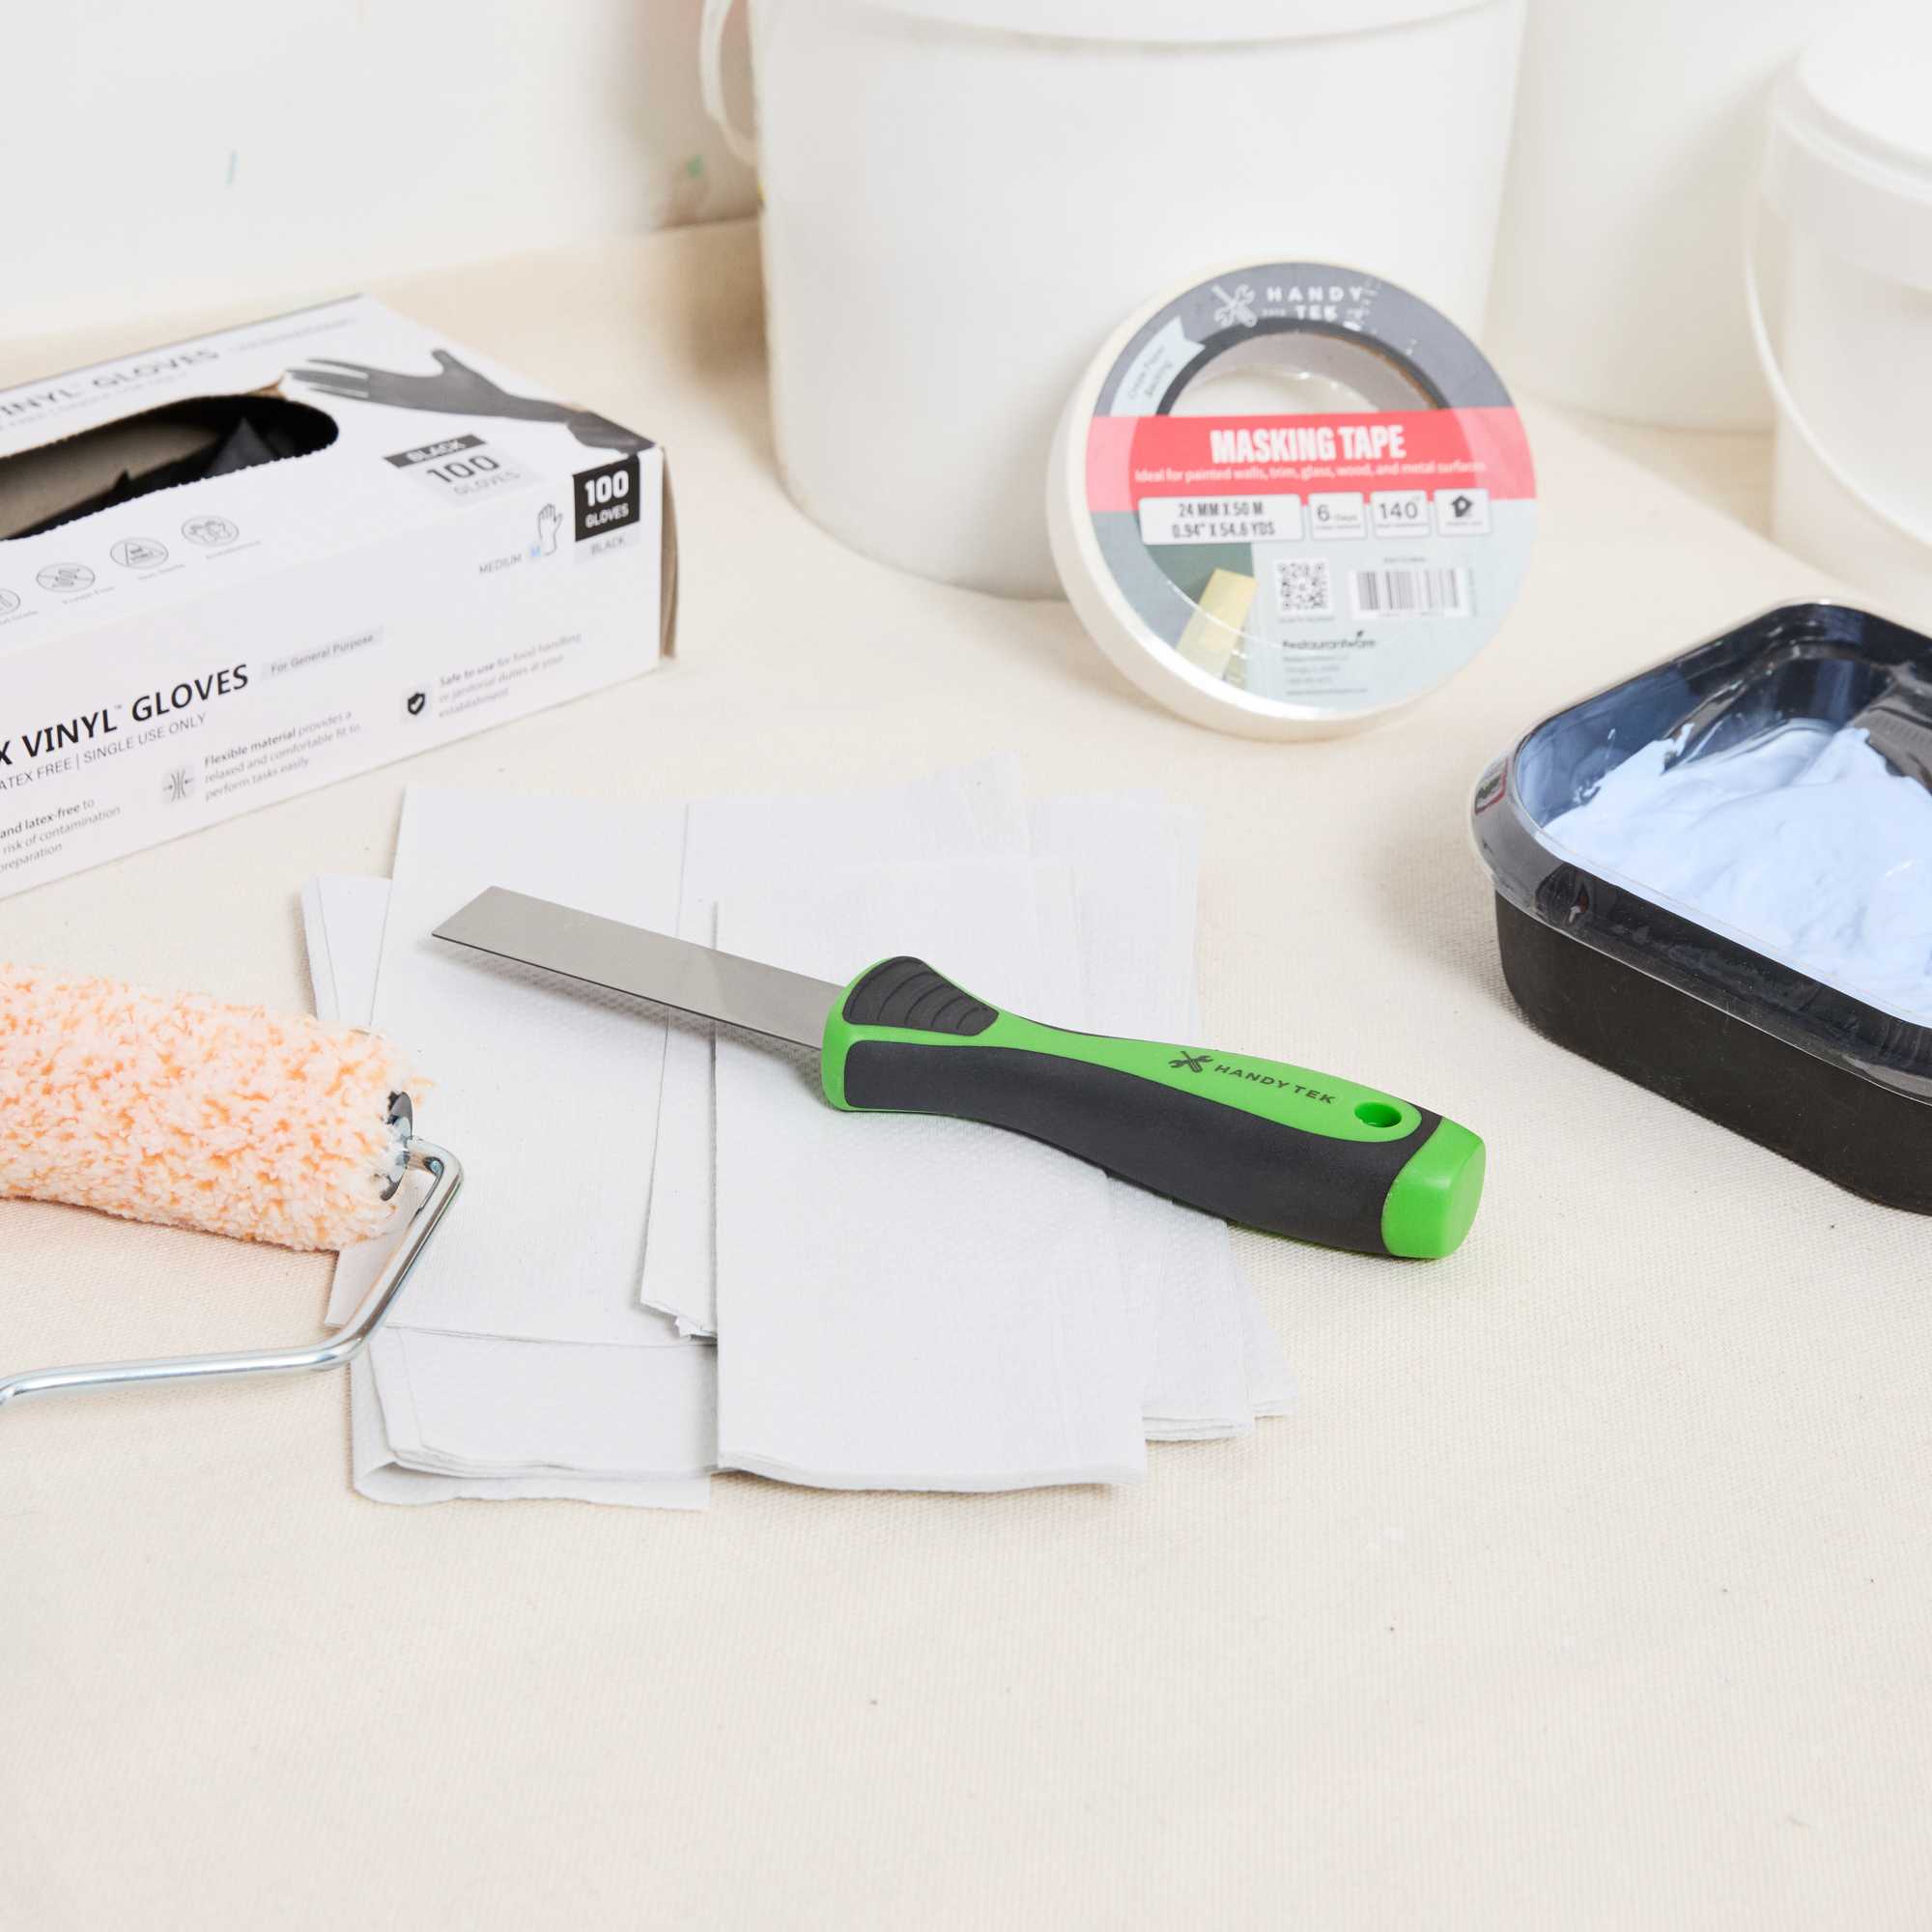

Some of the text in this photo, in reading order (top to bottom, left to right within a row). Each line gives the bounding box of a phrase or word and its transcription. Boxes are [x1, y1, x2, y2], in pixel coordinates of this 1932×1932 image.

[1266, 286, 1363, 302] HANDY
[1295, 305, 1338, 322] TEK
[406, 439, 468, 464] BLACK
[1209, 423, 1407, 465] MASKING TAPE
[426, 454, 500, 484] 100
[584, 469, 630, 507] 100
[585, 502, 630, 528] GLOVES
[1179, 502, 1194, 518] 24
[1197, 501, 1219, 517] MM
[1234, 500, 1250, 517] 50
[1253, 500, 1264, 516] M
[1316, 503, 1330, 523] 6
[590, 535, 626, 556] BLACK
[1251, 521, 1276, 536] YDS
[479, 553, 523, 575] MEDIUM
[270, 634, 375, 675] For General Purpose
[131, 664, 249, 723] GLOVES
[37, 756, 73, 781] FREE
[83, 736, 134, 765] SINGLE
[138, 726, 166, 746] USE
[169, 712, 209, 735] ONLY
[204, 745, 249, 769] Flexible
[251, 727, 298, 752] material
[298, 712, 344, 737] provides
[205, 762, 246, 784] relaxed
[247, 753, 269, 769] and
[270, 730, 334, 763] comfortable
[205, 755, 310, 803] perform tasks easily
[0, 820, 23, 840] and
[83, 798, 96, 811] to
[3, 807, 122, 856] risk of contamination
[1214, 1063, 1337, 1106] HANDY TEK
